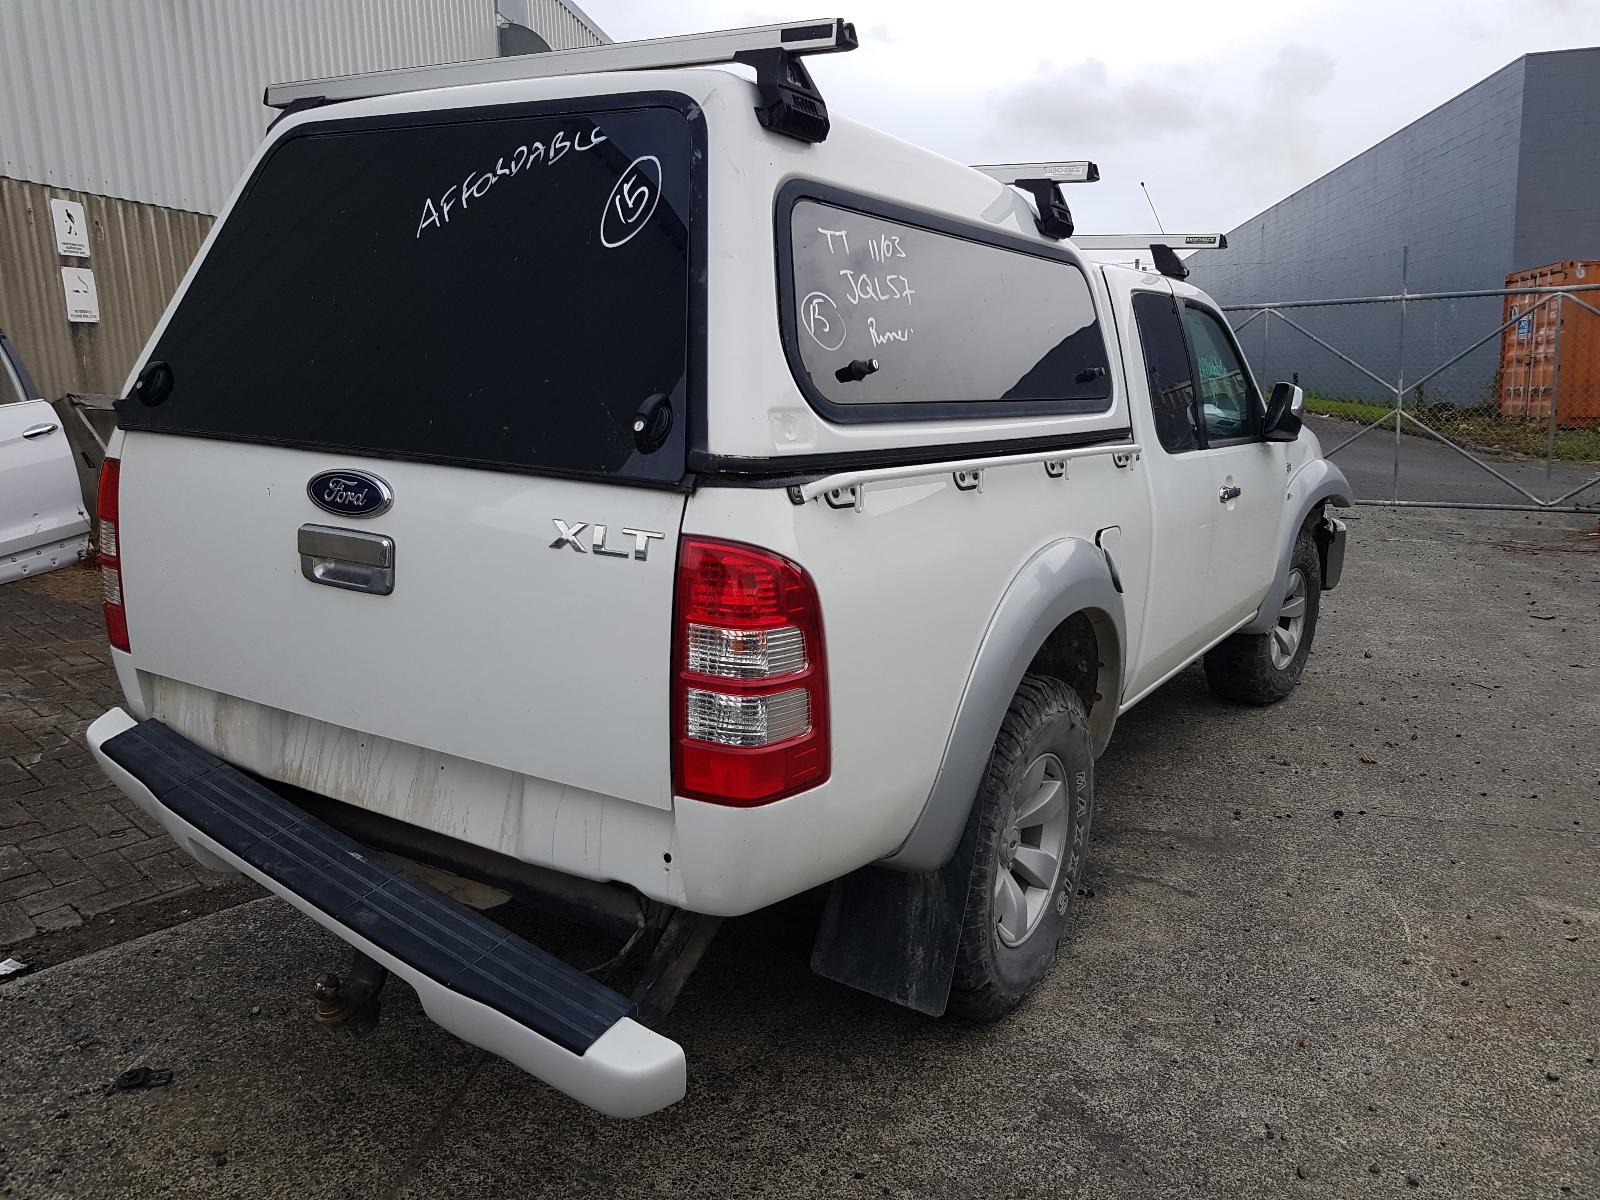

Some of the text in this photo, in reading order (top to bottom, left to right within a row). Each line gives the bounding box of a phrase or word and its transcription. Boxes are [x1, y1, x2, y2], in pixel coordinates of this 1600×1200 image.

[416, 126, 608, 239] AFFORDABLE
[615, 174, 649, 225] 15
[817, 227, 907, 264] TT 11/03
[839, 269, 916, 306] JQL57
[808, 298, 830, 335] 15
[323, 477, 369, 506] Ford
[548, 518, 665, 561] XLT
[1057, 770, 1087, 916] MAXXIS
